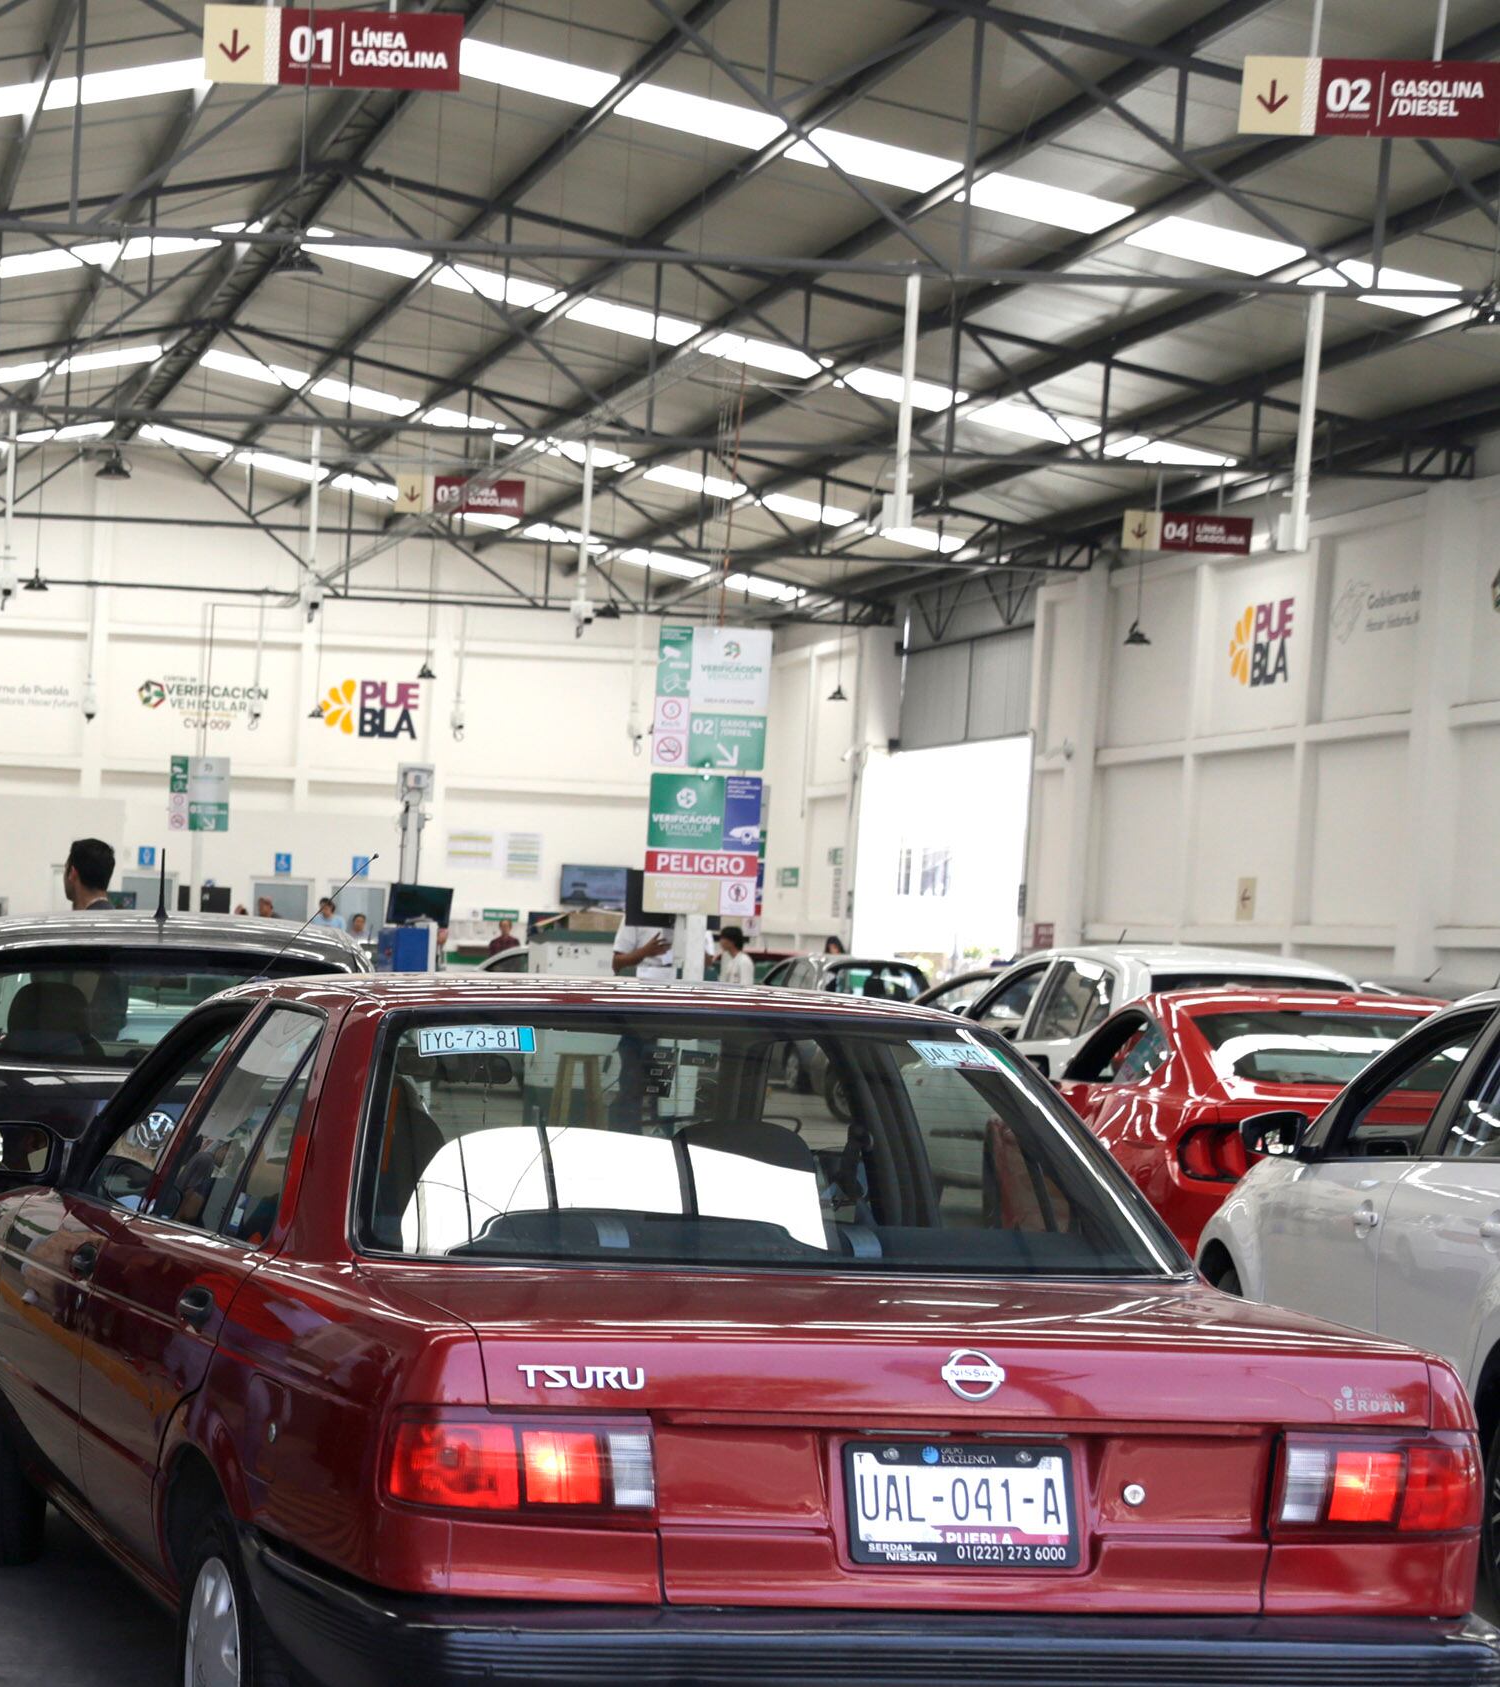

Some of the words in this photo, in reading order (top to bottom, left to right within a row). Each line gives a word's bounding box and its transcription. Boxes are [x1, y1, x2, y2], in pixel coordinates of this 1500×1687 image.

[288, 25, 333, 63] 01
[351, 27, 408, 49] LÍNEA
[350, 49, 448, 70] GASOLINA
[1325, 77, 1372, 112] 02
[1390, 80, 1485, 99] GASOLINA
[1388, 99, 1459, 118] /DIESEL
[468, 497, 518, 508] GASOLINA
[1163, 522, 1189, 541] 04
[1194, 534, 1245, 545] GASOLINA
[1254, 597, 1296, 641] PUE
[700, 663, 762, 674] VERIFICACIÓN
[1250, 638, 1288, 688] BLA
[34, 685, 70, 697] Puebla
[359, 680, 420, 710] PUE
[170, 698, 247, 712] VEHICULAR
[357, 707, 418, 740] BLA
[692, 719, 714, 735] 02
[720, 719, 764, 730] GASOLINA
[652, 812, 721, 825] VERIFICACIÓN
[659, 823, 712, 833] VEHICULAR
[656, 853, 746, 875] PELIGRO
[422, 1030, 517, 1051] TYC-73-81
[919, 1047, 992, 1067] UAL-041-
[517, 1364, 645, 1391] TSURU
[948, 1367, 1000, 1380] NISSAN
[1333, 1398, 1406, 1413] SERDAN
[940, 1447, 964, 1455] GRUPO
[941, 1454, 997, 1465] EXCELENCIA
[860, 1474, 1061, 1525] UAL-041-A
[868, 1543, 912, 1551] SERDAN
[956, 1545, 1004, 1562] 01(222)
[1008, 1546, 1031, 1561] 273
[1034, 1547, 1066, 1562] 6000
[886, 1551, 938, 1563] NISSAN
